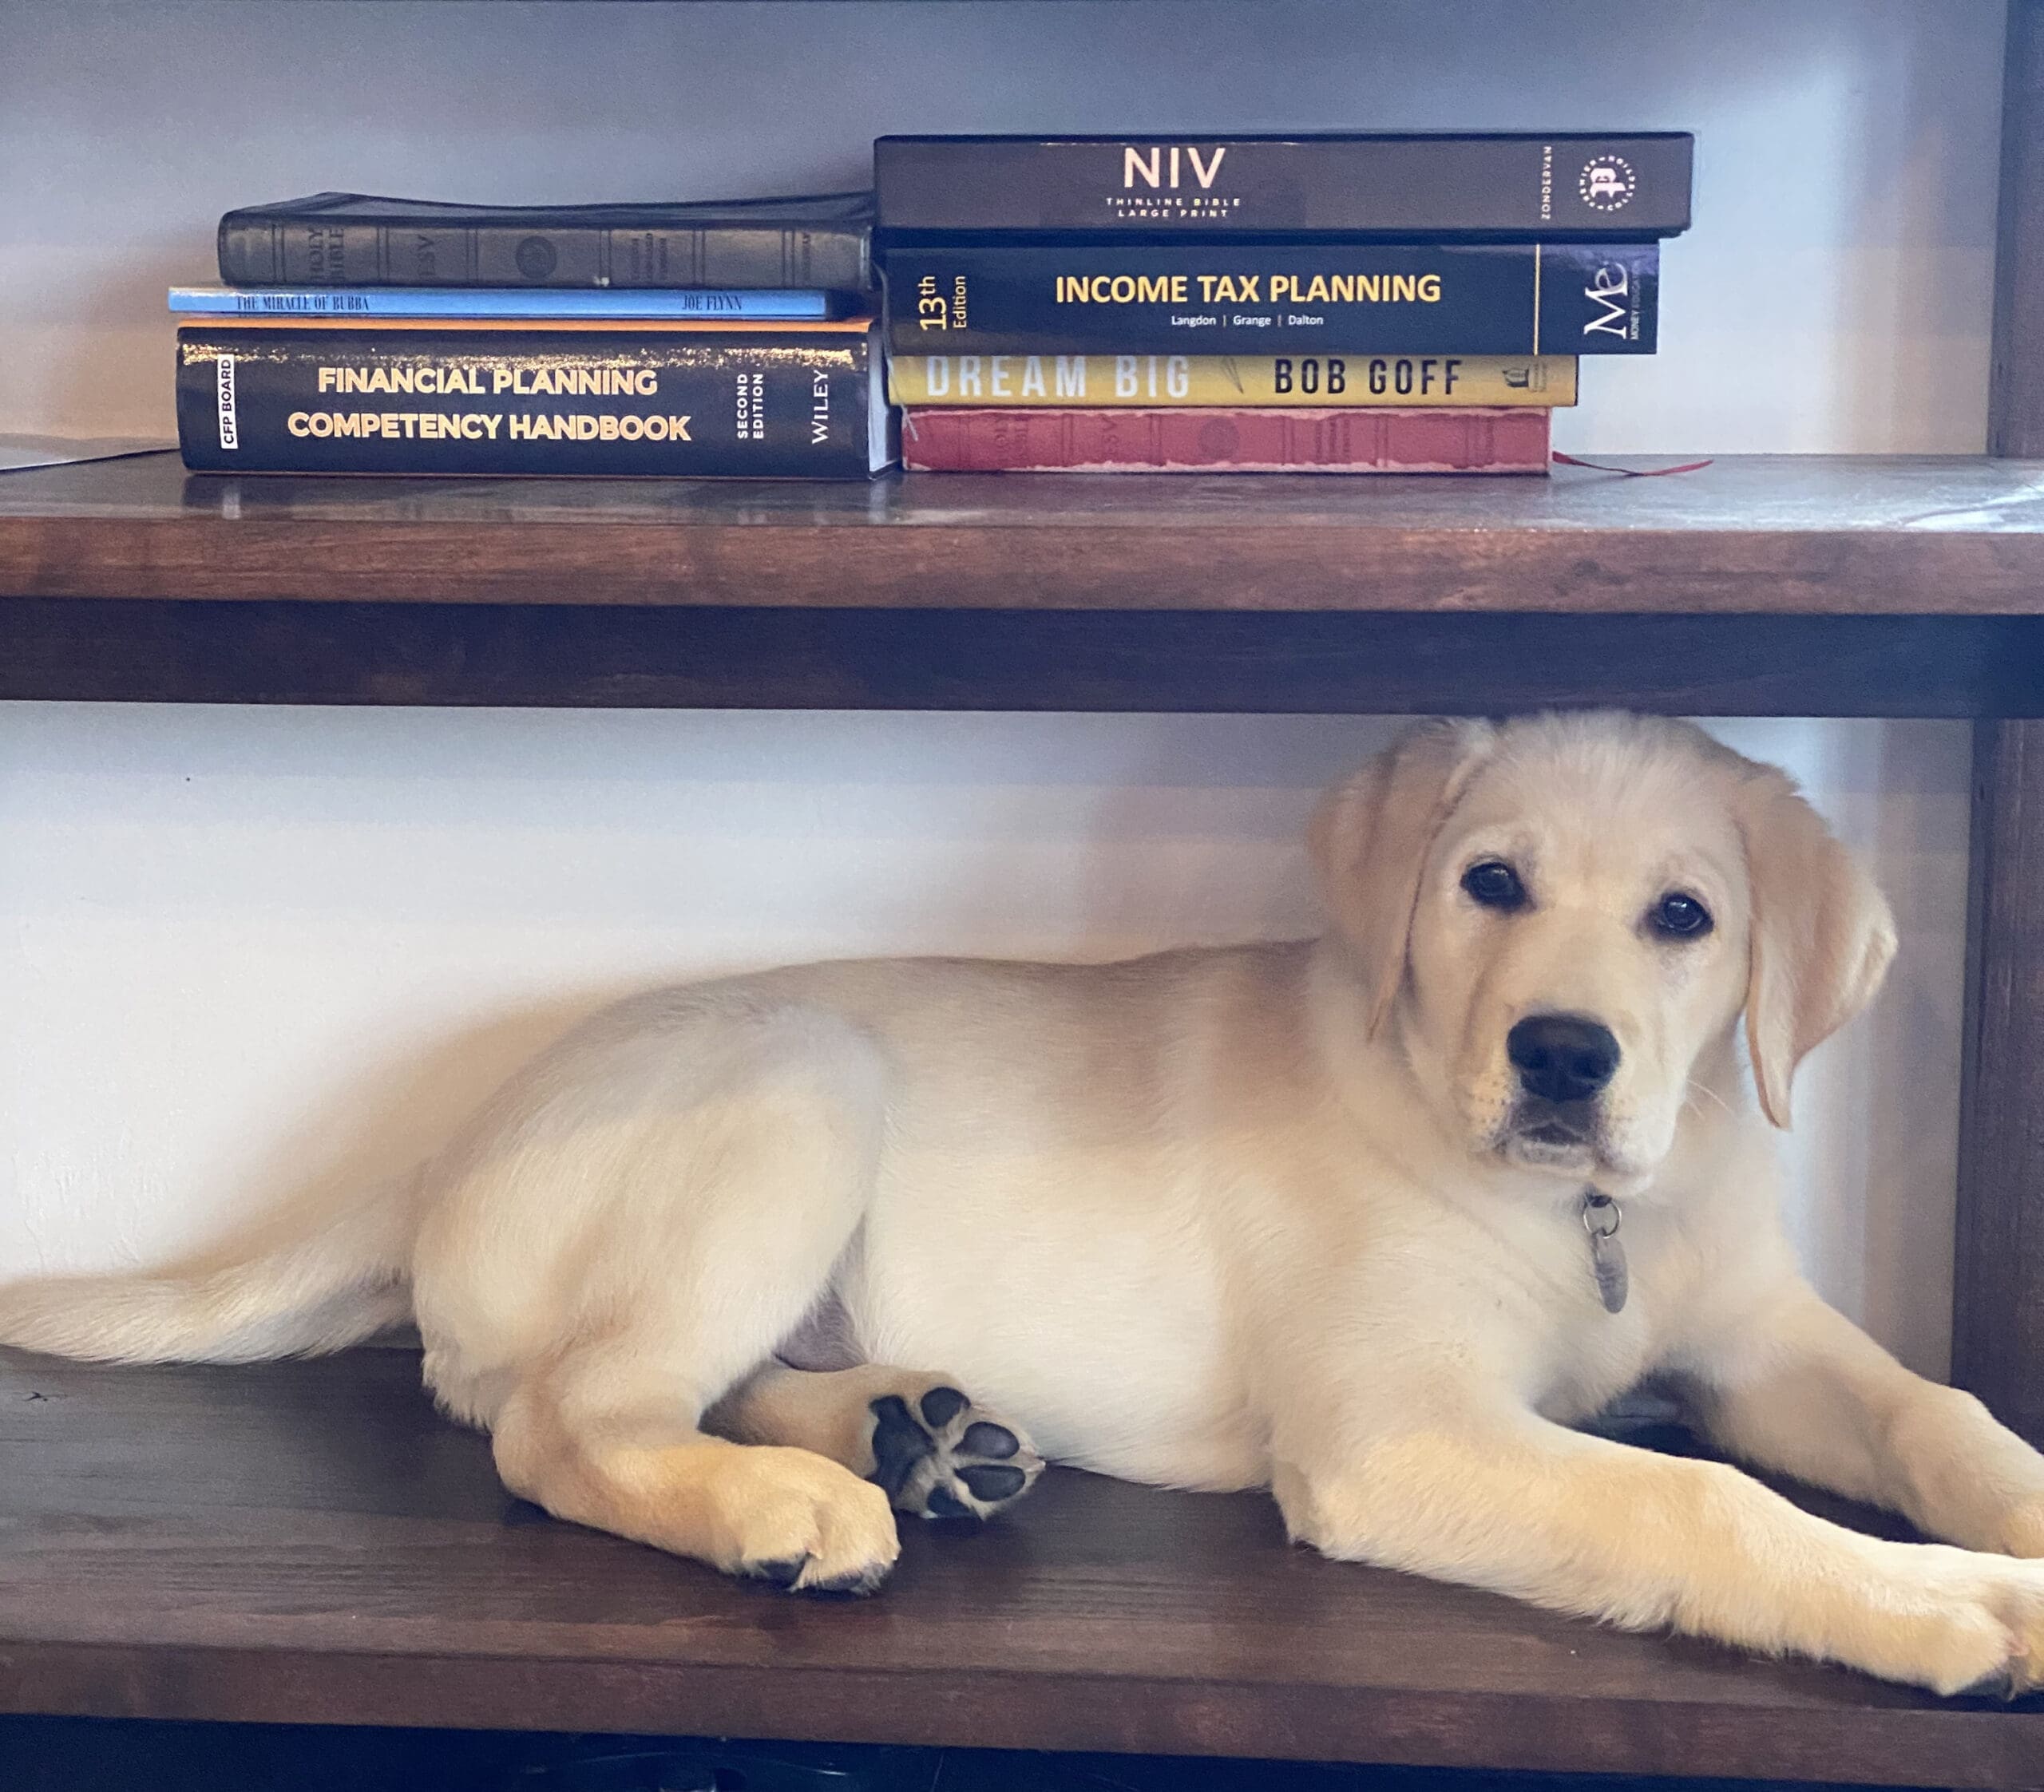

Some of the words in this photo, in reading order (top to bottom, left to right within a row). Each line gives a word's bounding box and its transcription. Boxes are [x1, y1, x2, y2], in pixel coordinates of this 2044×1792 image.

[1124, 147, 1226, 188] NIV
[1541, 146, 1552, 220] ZONDERVAN
[1106, 197, 1182, 206] THINLINE
[238, 296, 257, 310] THE
[263, 296, 309, 310] MIRACLE
[315, 296, 327, 310] OF
[333, 296, 368, 310] BUBBA
[683, 296, 703, 311] JOE
[707, 296, 743, 311] FLYNN
[919, 276, 947, 331] 13th
[953, 276, 966, 329] Edition
[1056, 275, 1188, 303] INCOME
[1198, 275, 1260, 303] TAX
[1270, 275, 1440, 303] PLANNING
[1171, 315, 1216, 326] Langdon
[1233, 315, 1271, 326] Grange
[1289, 314, 1324, 325] Dalton
[1630, 311, 1640, 340] MONEY
[220, 358, 234, 413] BOARD
[319, 367, 485, 394] FINANCIAL
[493, 369, 658, 395] PLANNING
[927, 356, 1086, 398] DREAM
[1116, 356, 1189, 398] BIG
[1275, 359, 1345, 394] BOB
[1369, 359, 1463, 394] GOFF
[737, 374, 748, 439] SECOND
[753, 374, 763, 439] EDITION
[812, 370, 829, 444] WILEY
[222, 414, 236, 445] CFP
[287, 412, 503, 440] COMPETENCY
[509, 413, 691, 441] HANDBOOK
